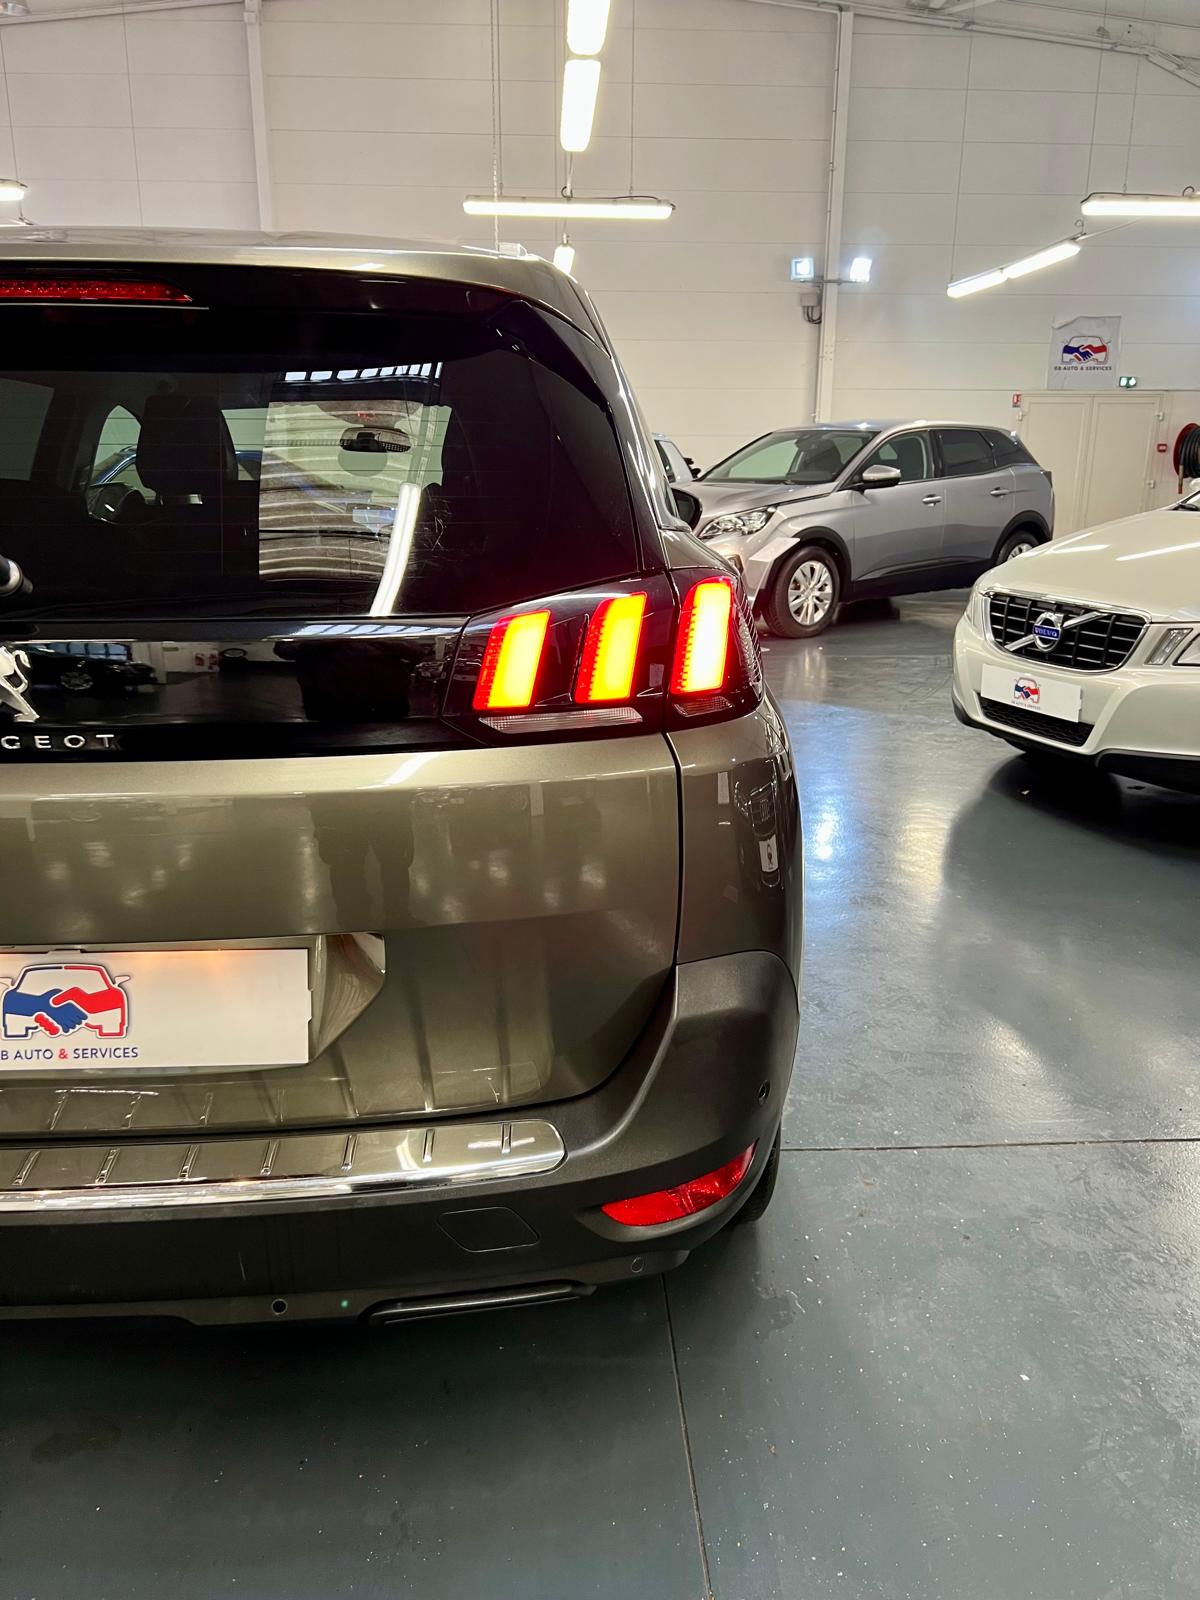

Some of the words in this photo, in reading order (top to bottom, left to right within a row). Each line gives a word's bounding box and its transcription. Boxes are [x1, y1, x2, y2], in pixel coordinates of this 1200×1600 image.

[1034, 626, 1058, 637] VOLVO
[13, 1048, 54, 1060] AUTO
[58, 1048, 68, 1060] &
[73, 1047, 139, 1059] SERVICES
